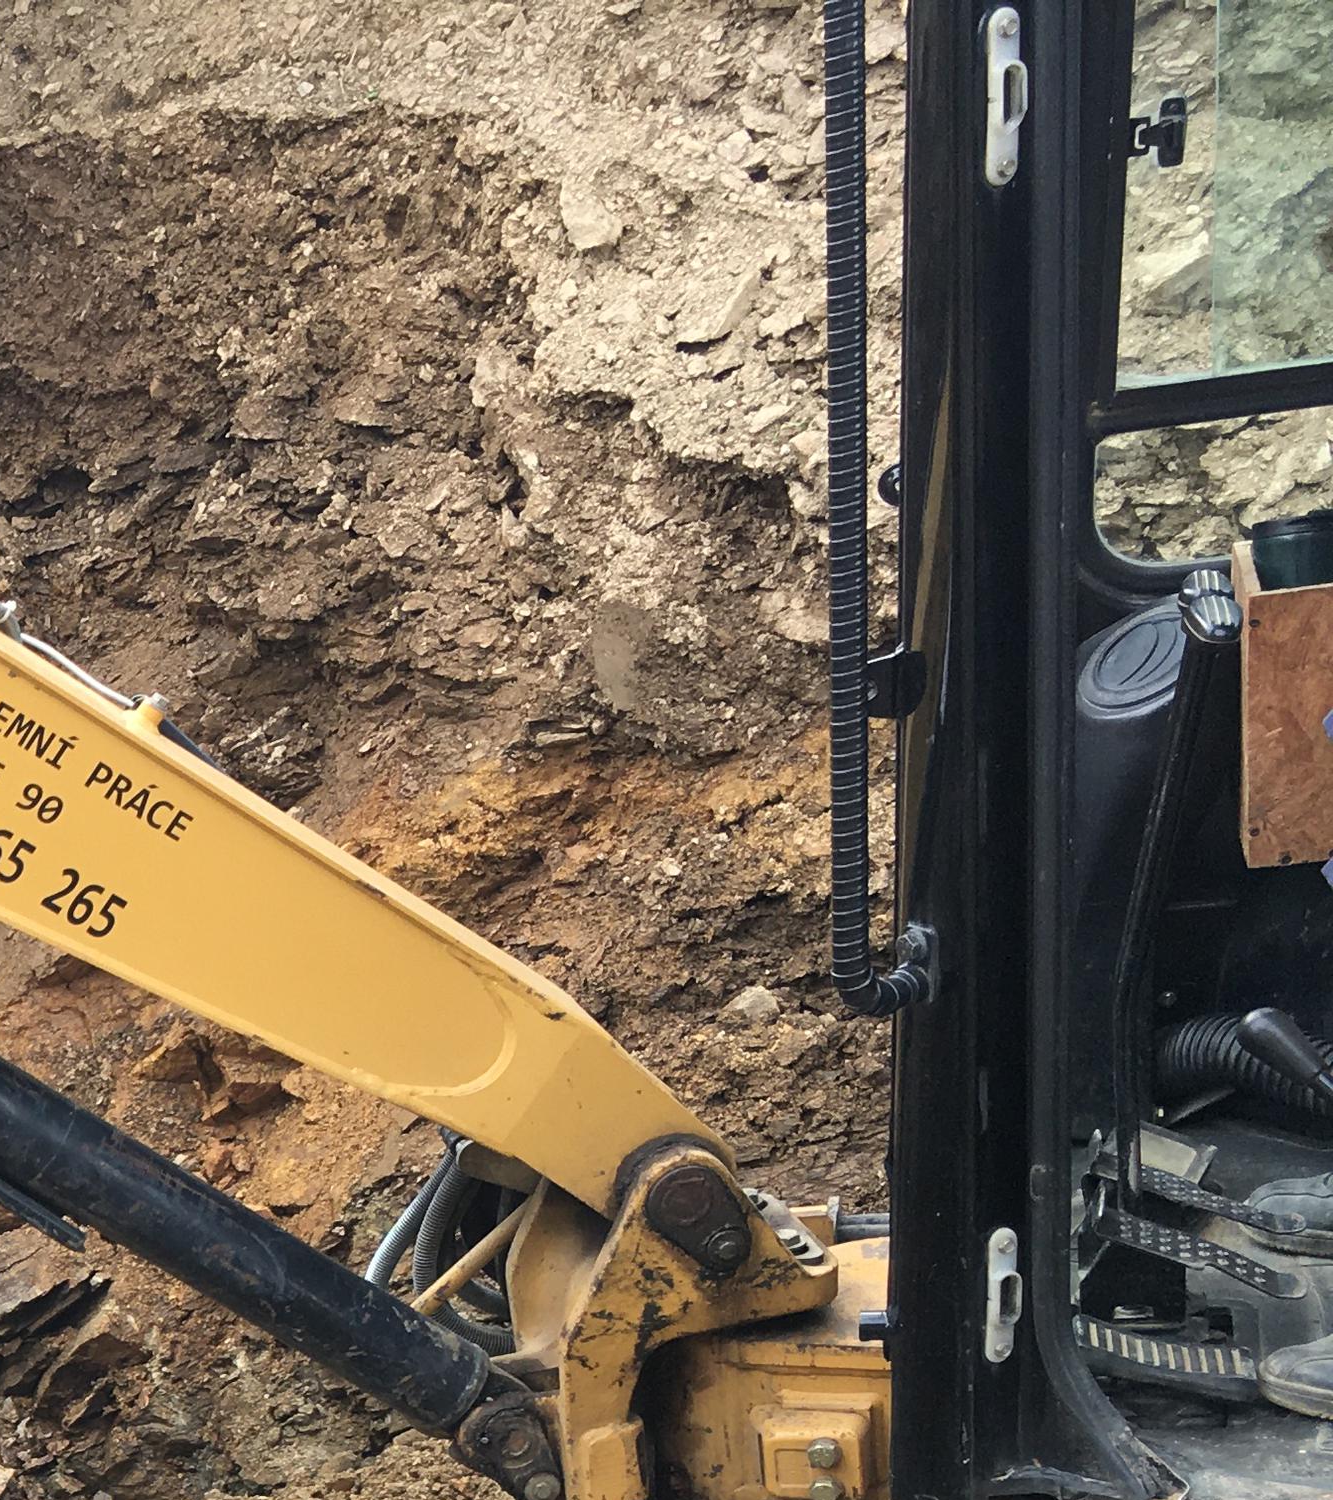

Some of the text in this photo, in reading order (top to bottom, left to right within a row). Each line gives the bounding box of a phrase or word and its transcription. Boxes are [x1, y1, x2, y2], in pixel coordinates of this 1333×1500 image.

[15, 782, 65, 825] 90
[84, 760, 195, 842] PRÁCE
[40, 867, 129, 939] 265
